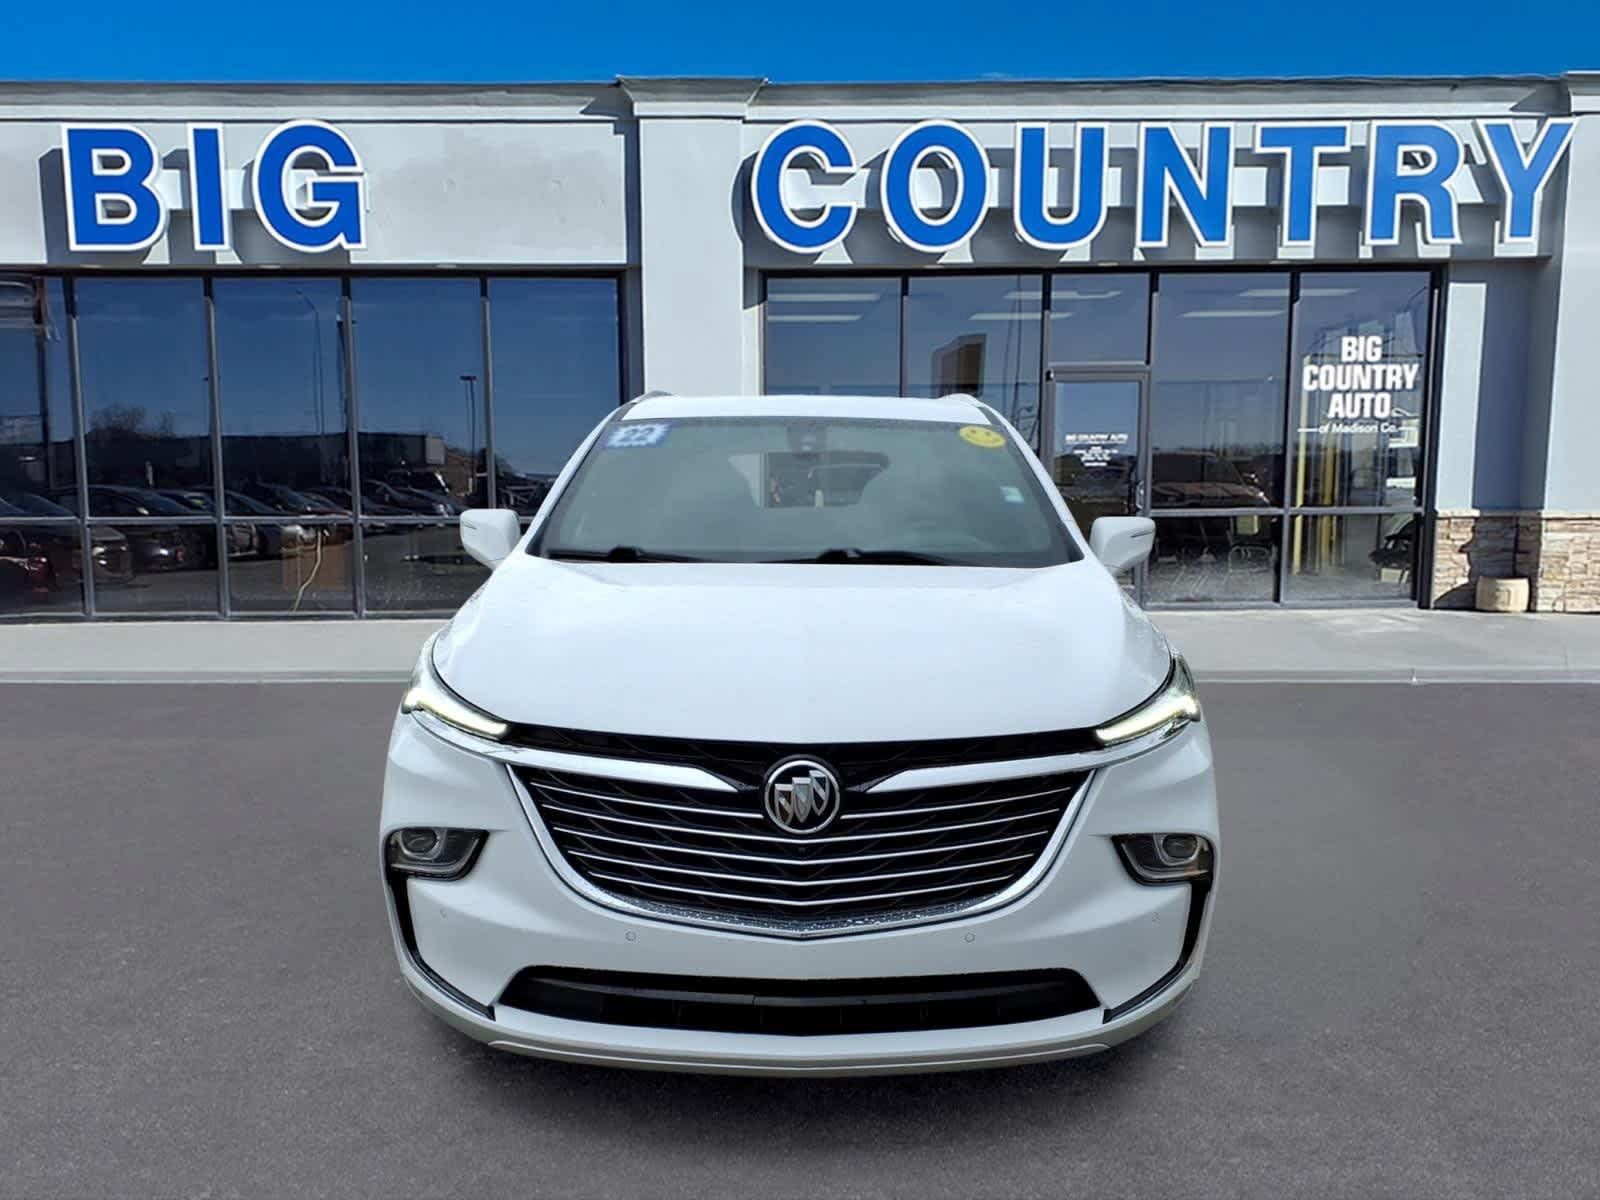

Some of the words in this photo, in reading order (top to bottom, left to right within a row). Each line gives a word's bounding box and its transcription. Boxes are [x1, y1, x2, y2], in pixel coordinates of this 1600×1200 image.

[61, 119, 368, 253] BIG
[751, 119, 1576, 254] COUNTRY
[1341, 335, 1382, 362] BIG
[1303, 363, 1420, 391] COUNTRY
[1328, 392, 1391, 419] AUTO
[1332, 423, 1378, 433] Madison
